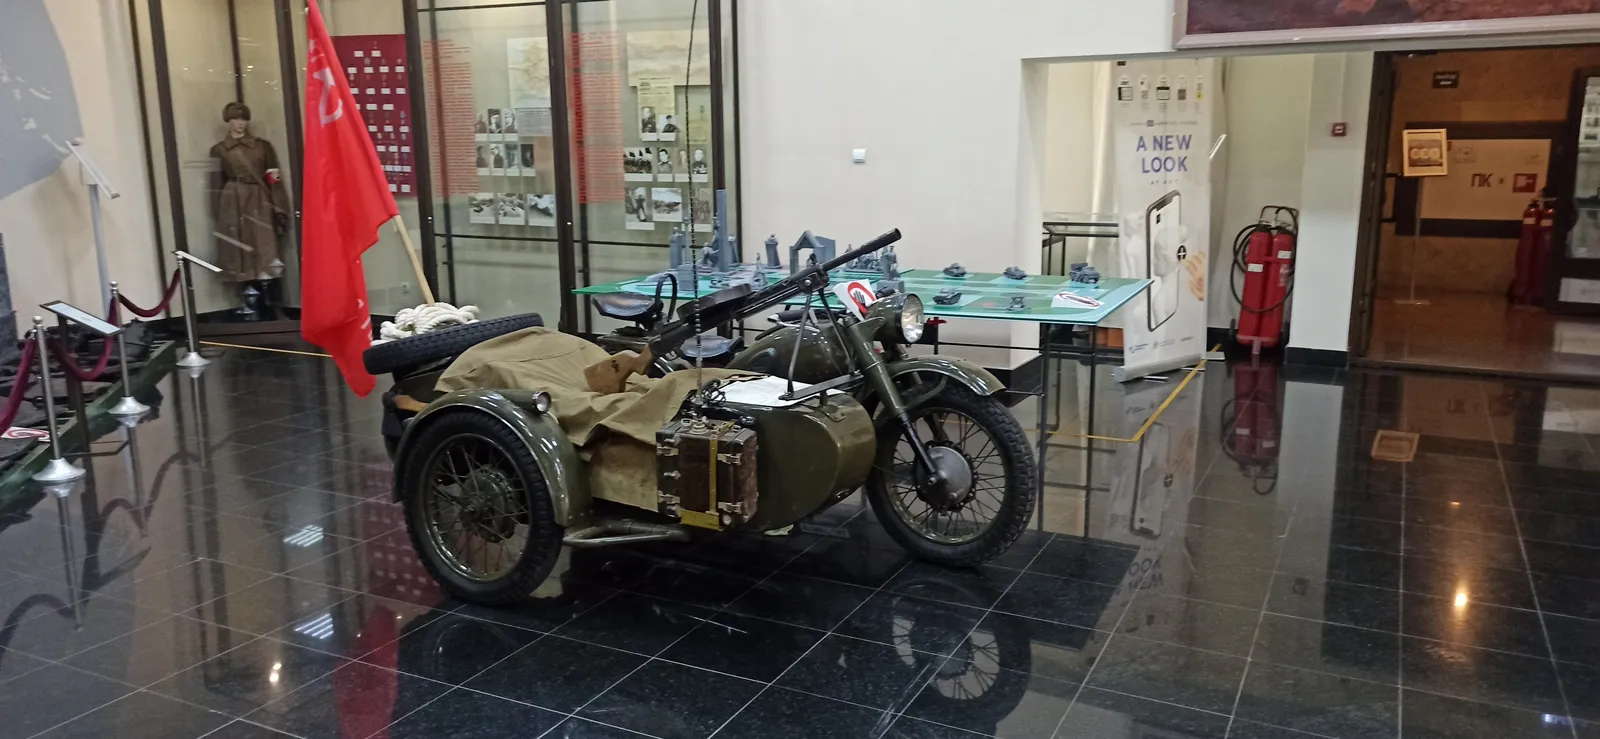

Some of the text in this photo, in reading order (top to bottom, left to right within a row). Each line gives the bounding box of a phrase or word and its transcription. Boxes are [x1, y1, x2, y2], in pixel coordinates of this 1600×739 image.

[1136, 135, 1192, 152] A NEW
[1142, 156, 1187, 173] LOOK
[1471, 174, 1493, 187] ПК
